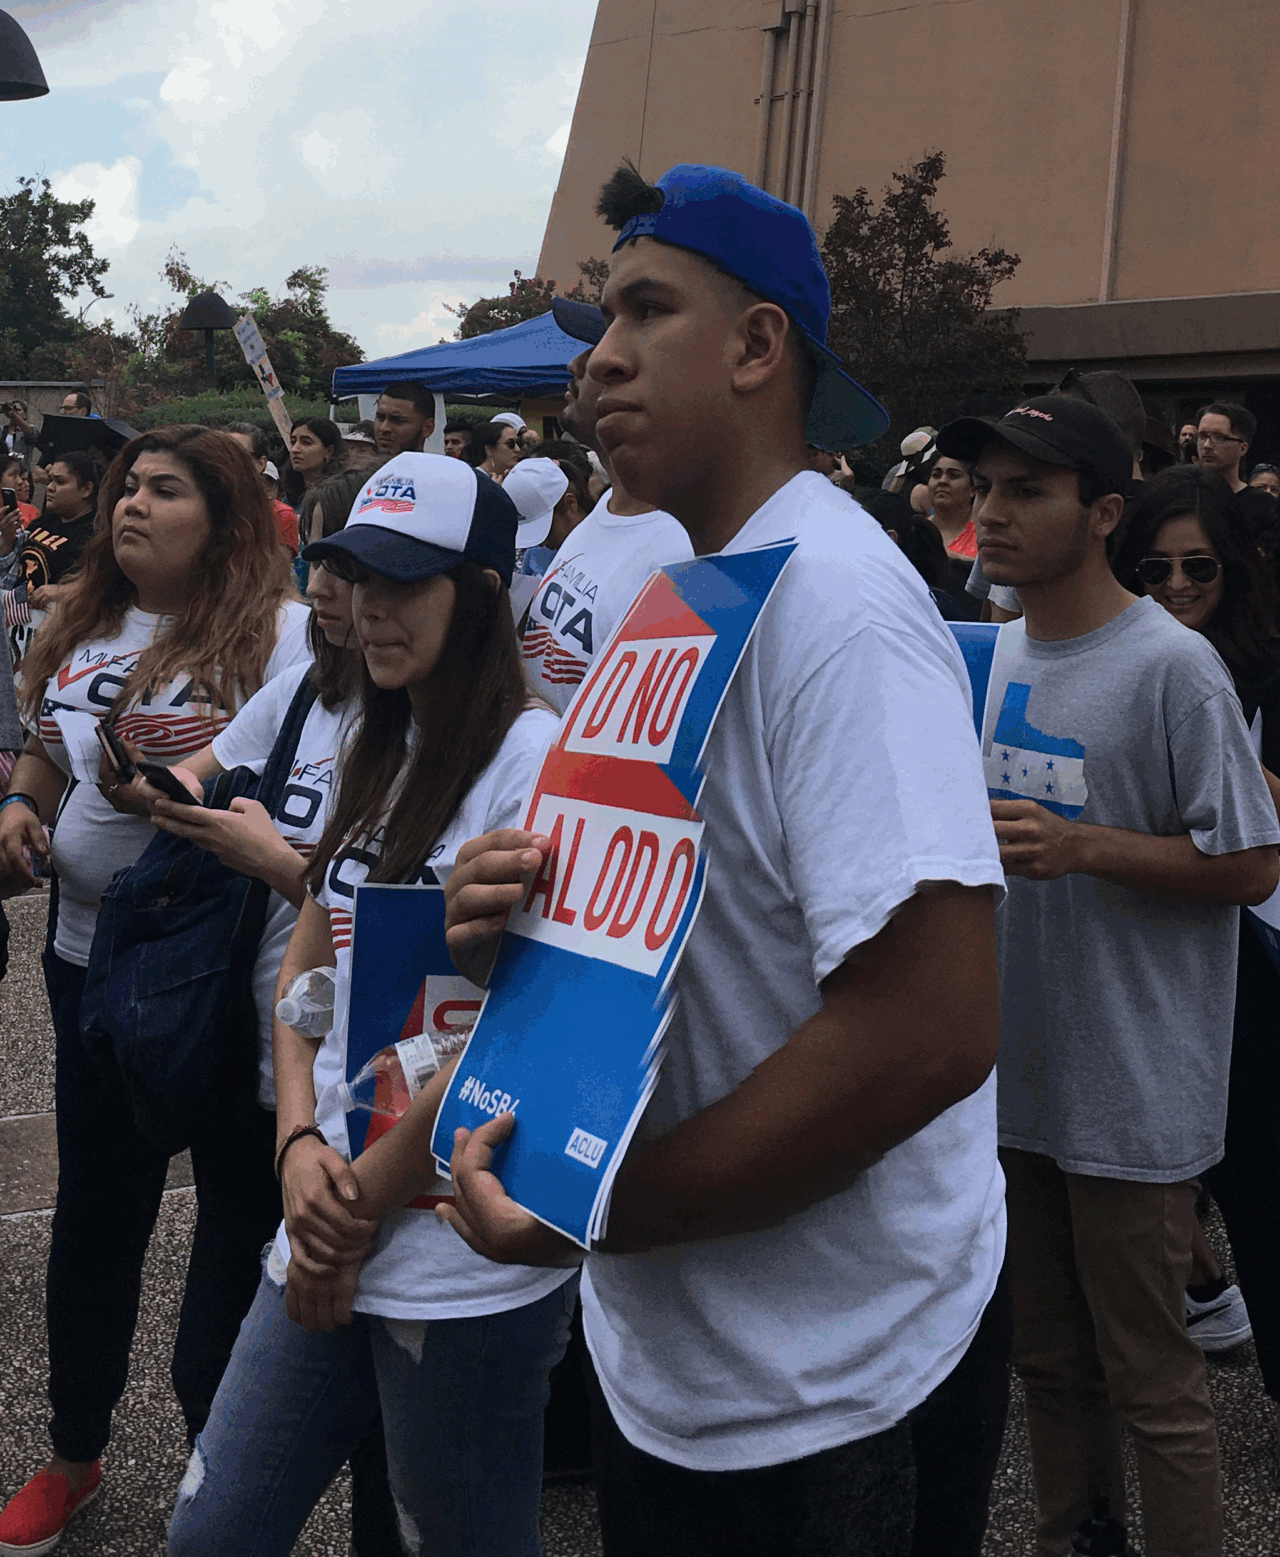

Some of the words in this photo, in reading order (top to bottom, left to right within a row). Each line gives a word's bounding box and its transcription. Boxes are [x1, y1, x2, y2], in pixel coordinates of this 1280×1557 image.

[616, 646, 699, 746] NO
[523, 813, 586, 926] AL
[583, 825, 695, 951] ODO
[570, 1133, 603, 1162] ACLU
